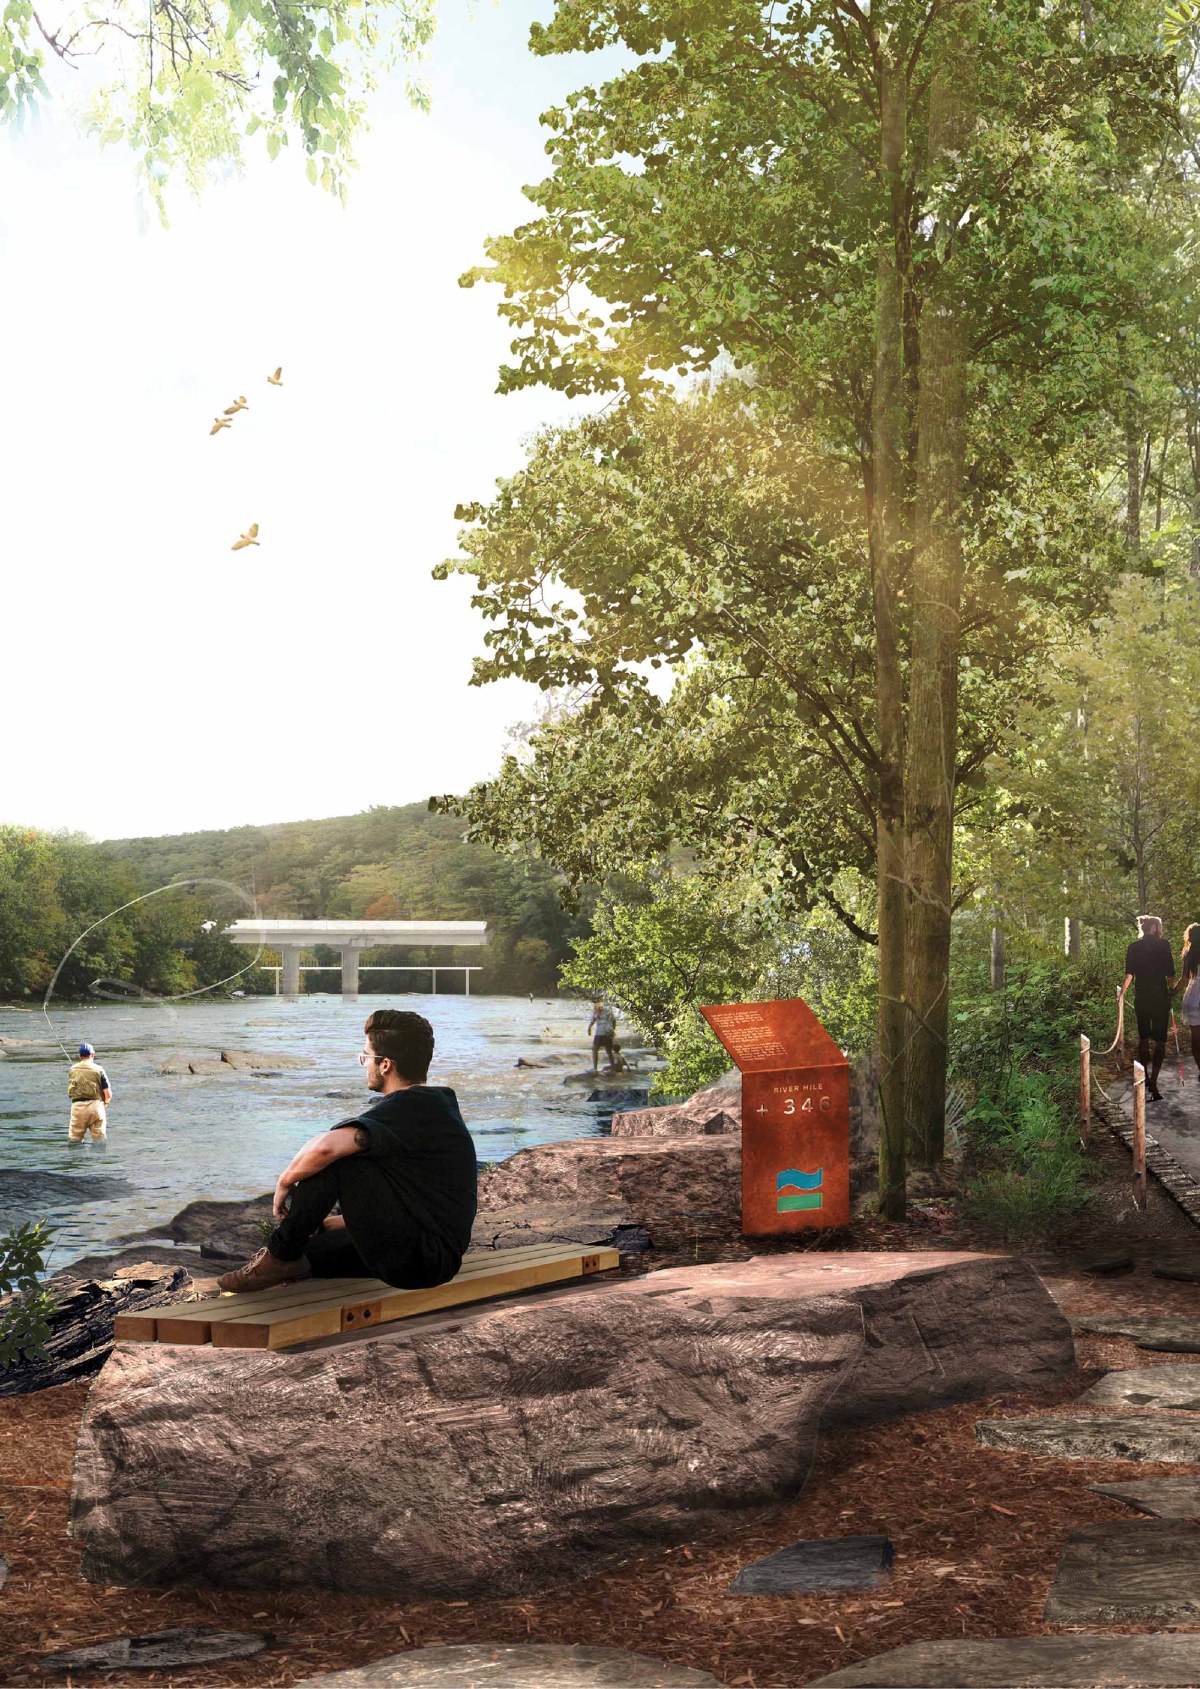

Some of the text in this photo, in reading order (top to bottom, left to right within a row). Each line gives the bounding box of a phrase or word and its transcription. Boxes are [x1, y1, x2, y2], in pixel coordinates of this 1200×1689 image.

[773, 1083, 823, 1094] RIVER MILE
[783, 1096, 832, 1115] 346
